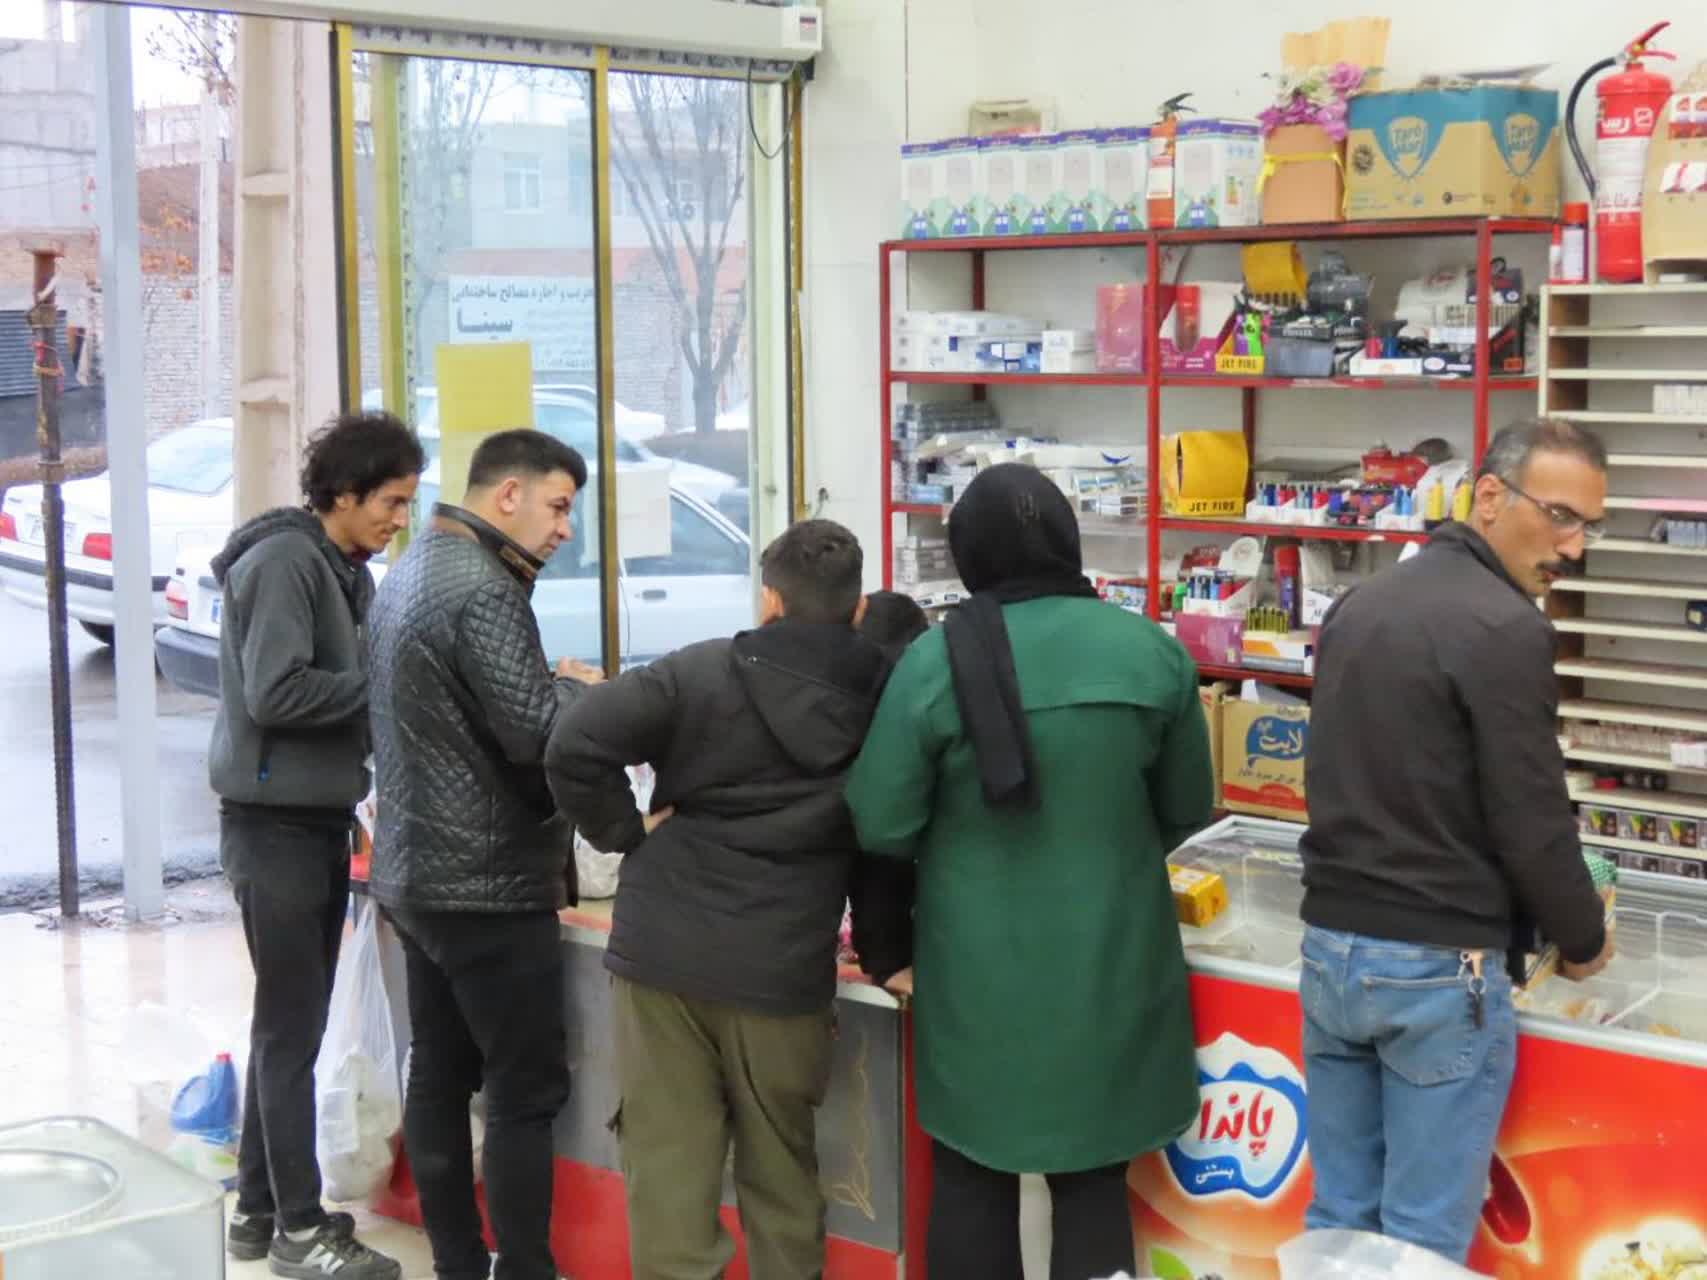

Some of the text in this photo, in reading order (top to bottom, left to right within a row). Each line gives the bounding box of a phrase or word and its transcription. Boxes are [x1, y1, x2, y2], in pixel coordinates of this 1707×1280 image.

[1221, 358, 1235, 369] JET
[1189, 500, 1235, 513] JET FIRE
[1199, 1089, 1274, 1158] پاندا
